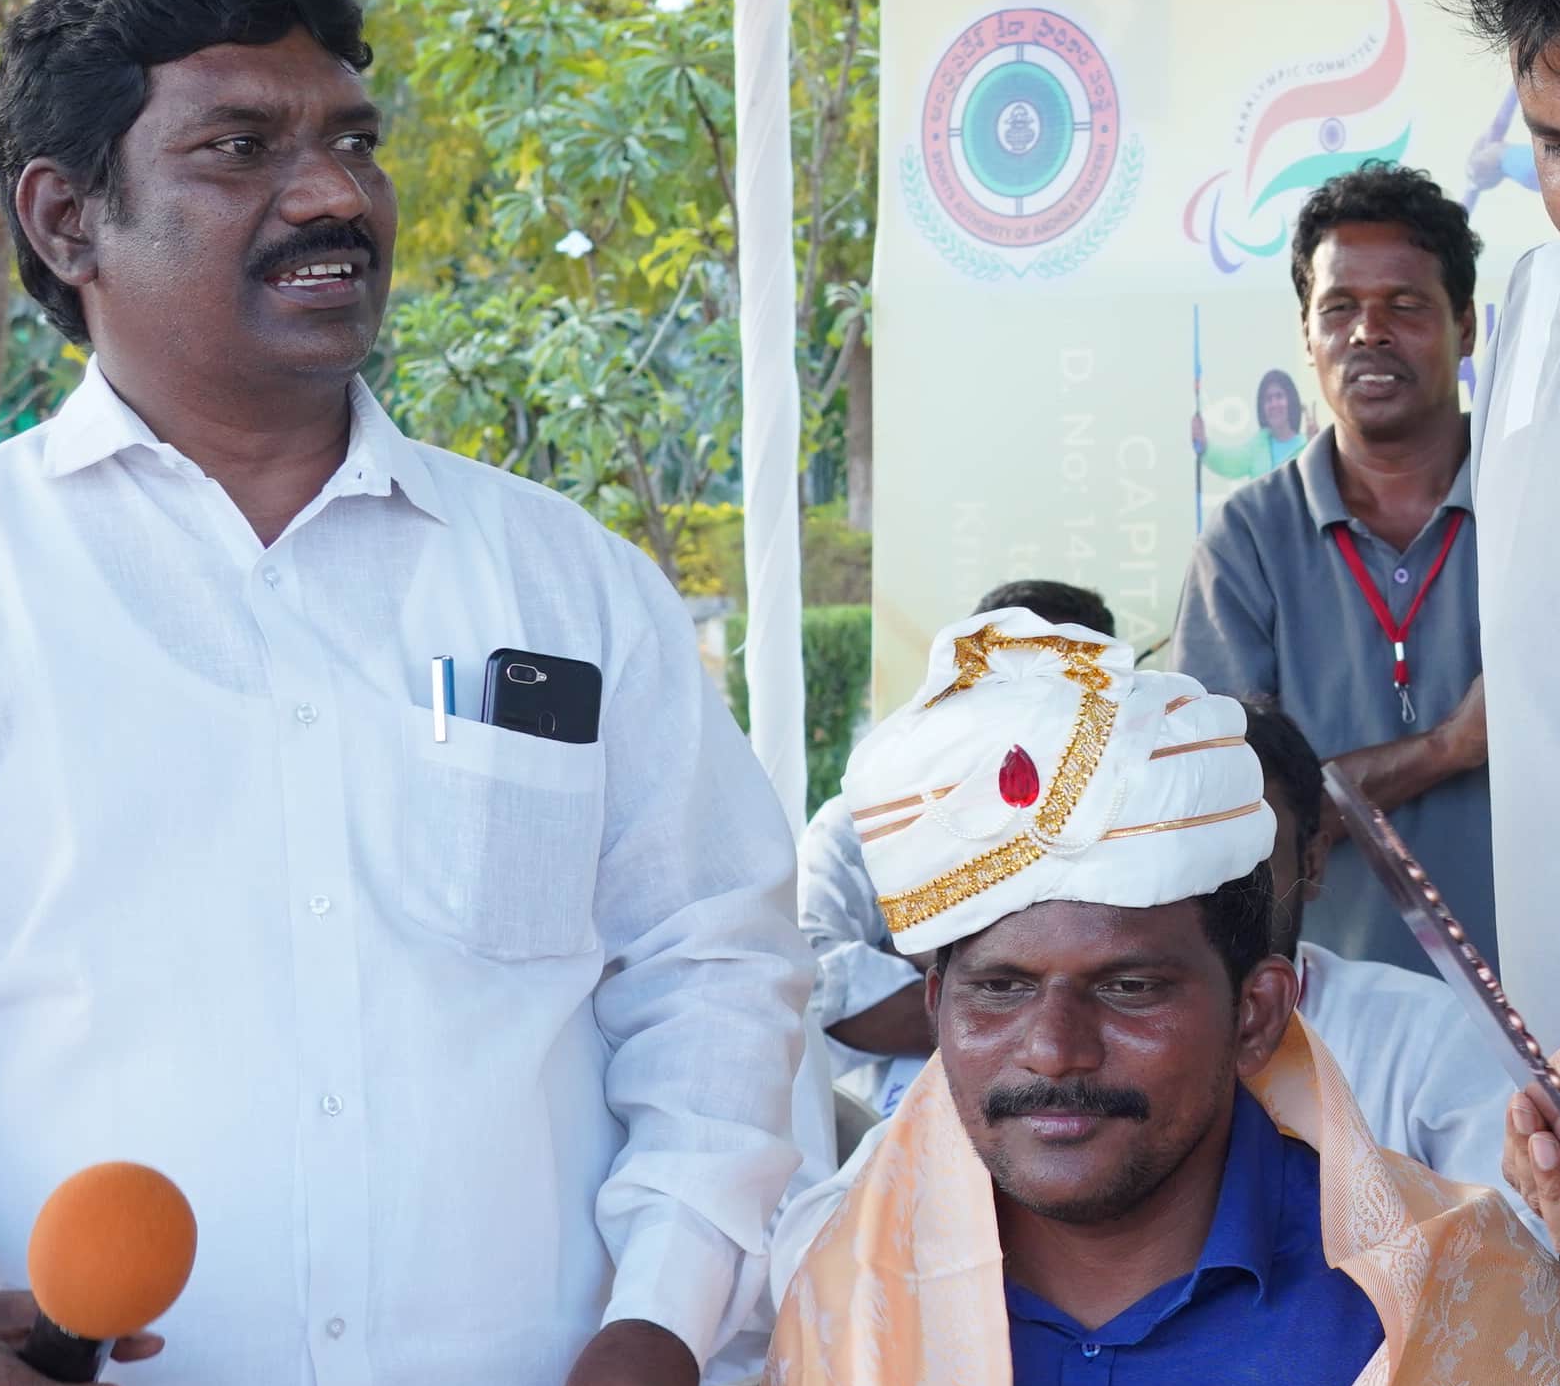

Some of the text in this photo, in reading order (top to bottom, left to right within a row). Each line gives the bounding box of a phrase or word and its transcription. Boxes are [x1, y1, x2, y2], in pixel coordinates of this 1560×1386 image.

[1234, 32, 1379, 146] PARALYMPIC COMMITTEE
[1014, 226, 1031, 240] OF
[1113, 433, 1159, 648] CAPITA
